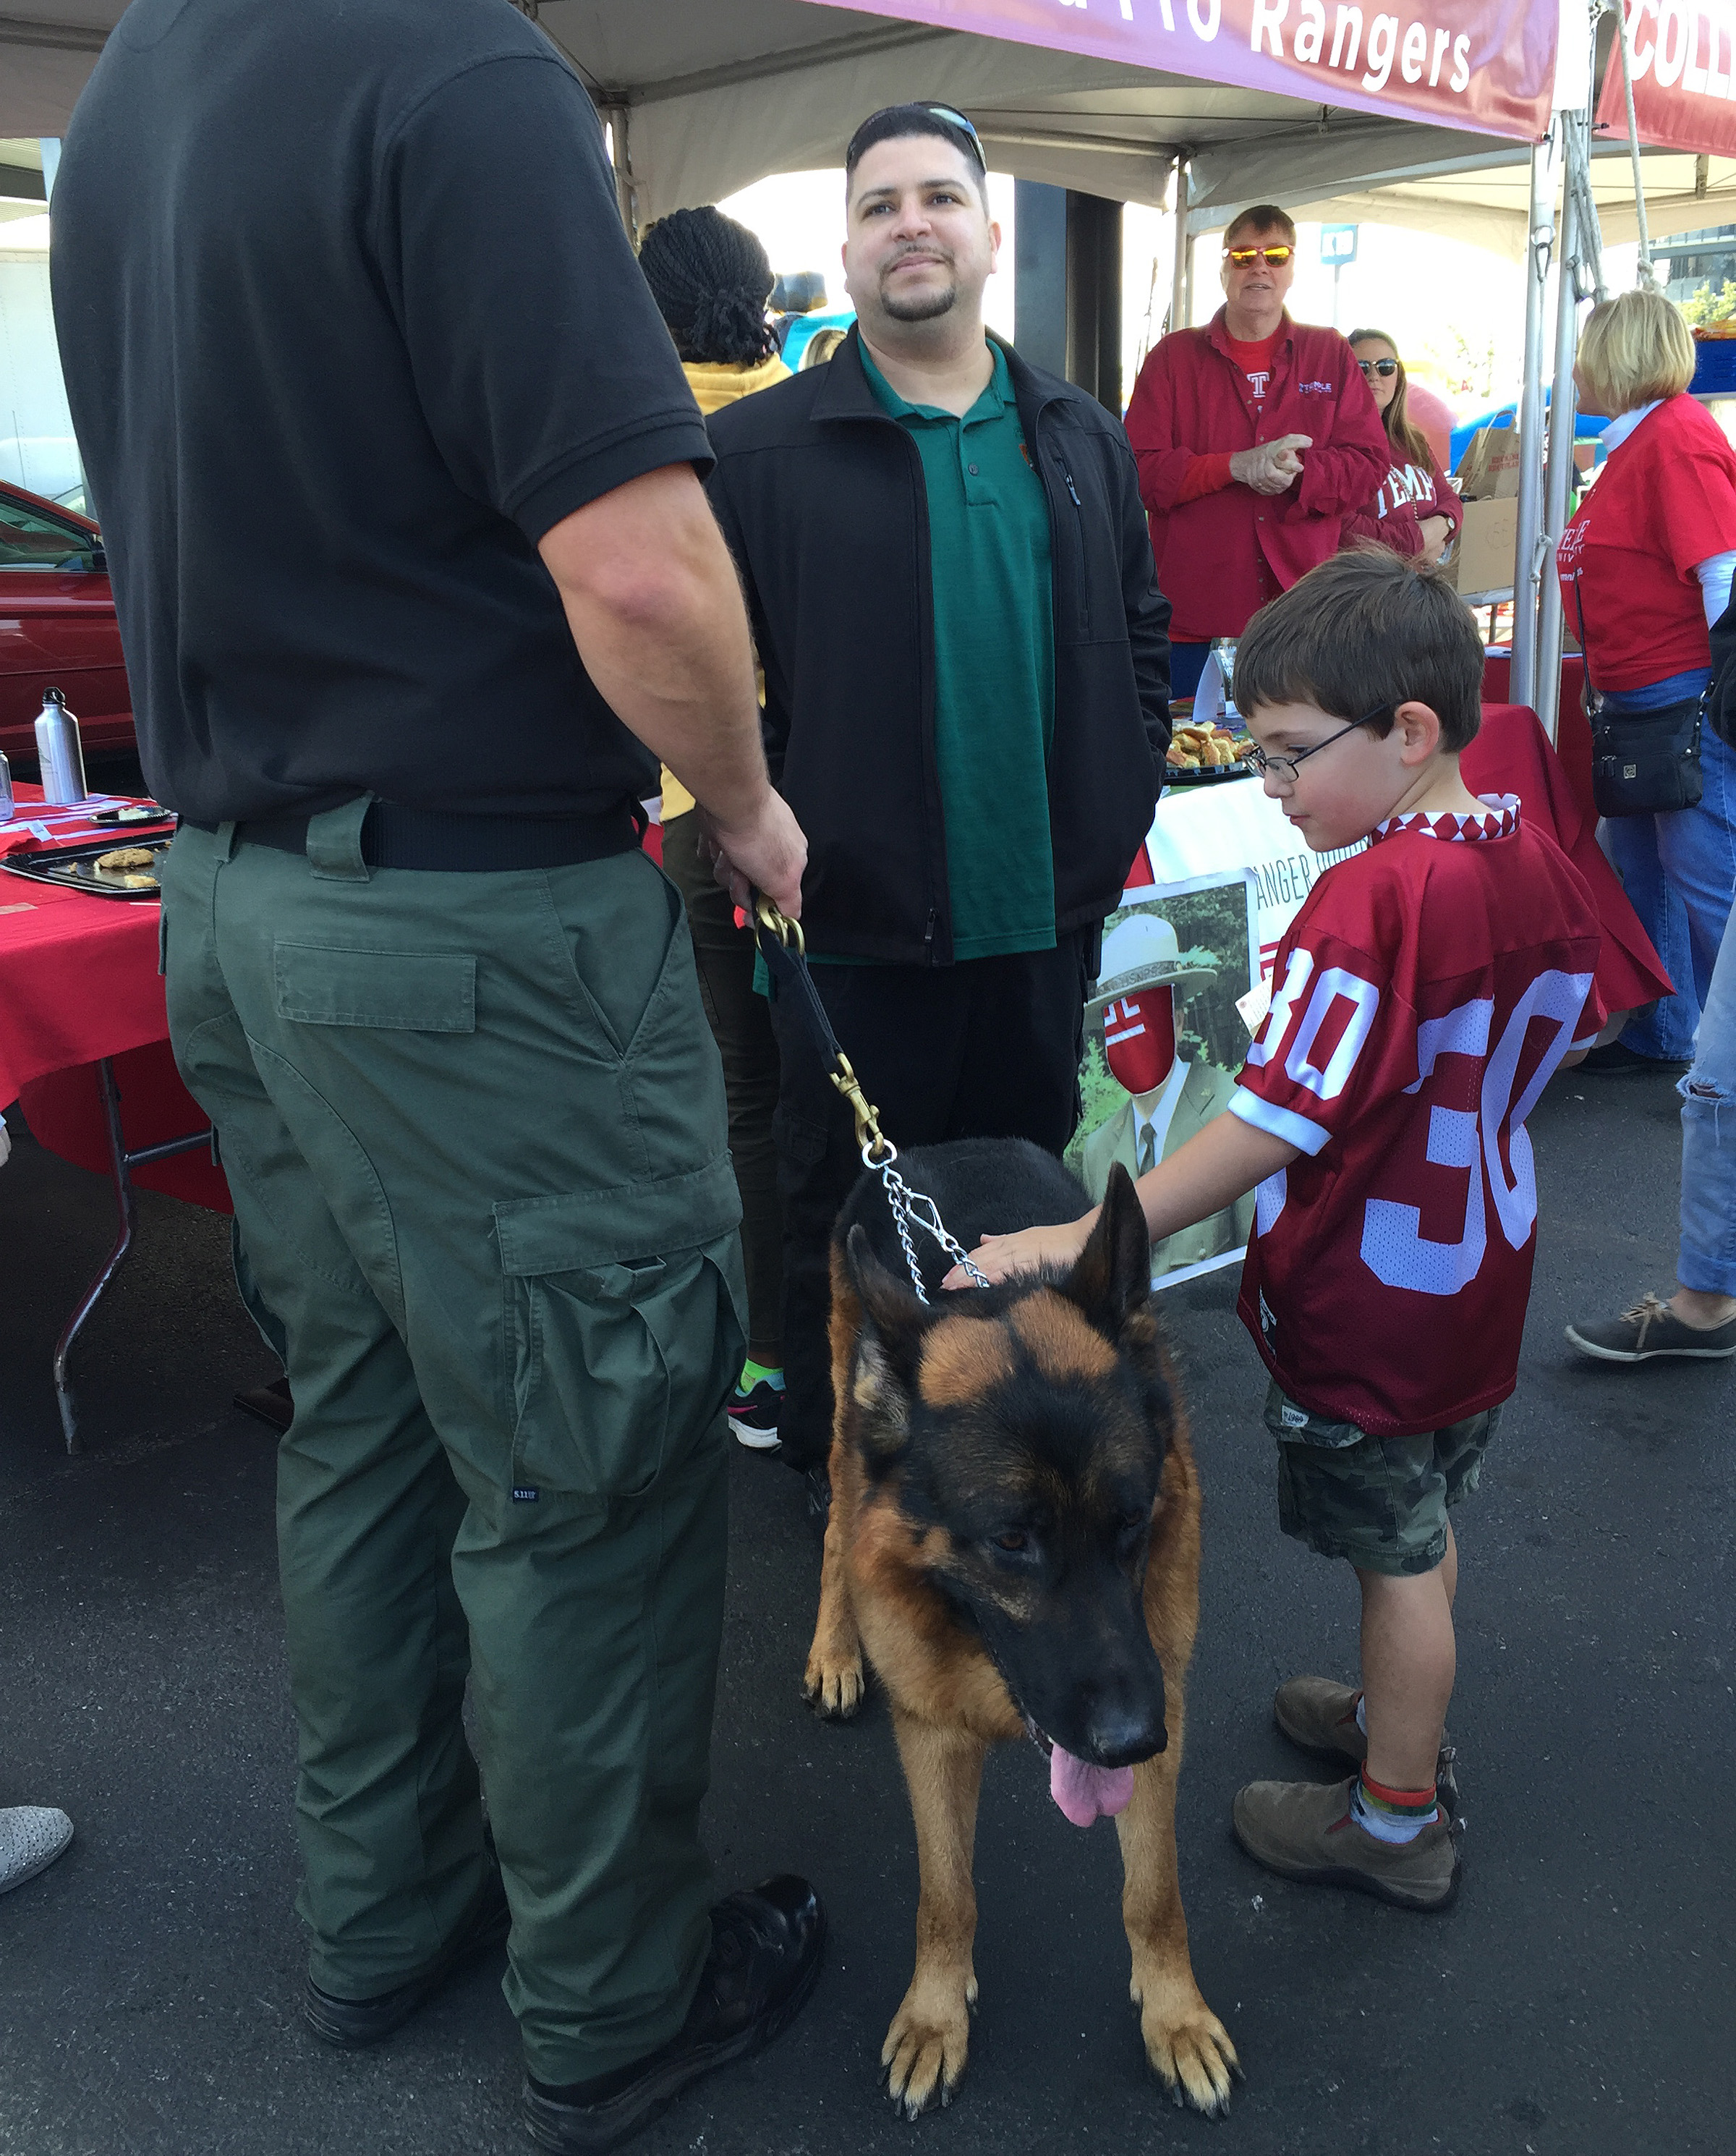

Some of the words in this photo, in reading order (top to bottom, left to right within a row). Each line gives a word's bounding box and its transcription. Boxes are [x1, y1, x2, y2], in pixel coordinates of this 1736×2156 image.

[1251, 0, 1471, 93] Rangers
[1625, 0, 1736, 101] COLL
[1246, 371, 1270, 398] T
[1377, 463, 1437, 519] TEMP
[1254, 854, 1314, 910] ANGER
[1246, 946, 1379, 1100] 30
[1360, 969, 1594, 1296] 30
